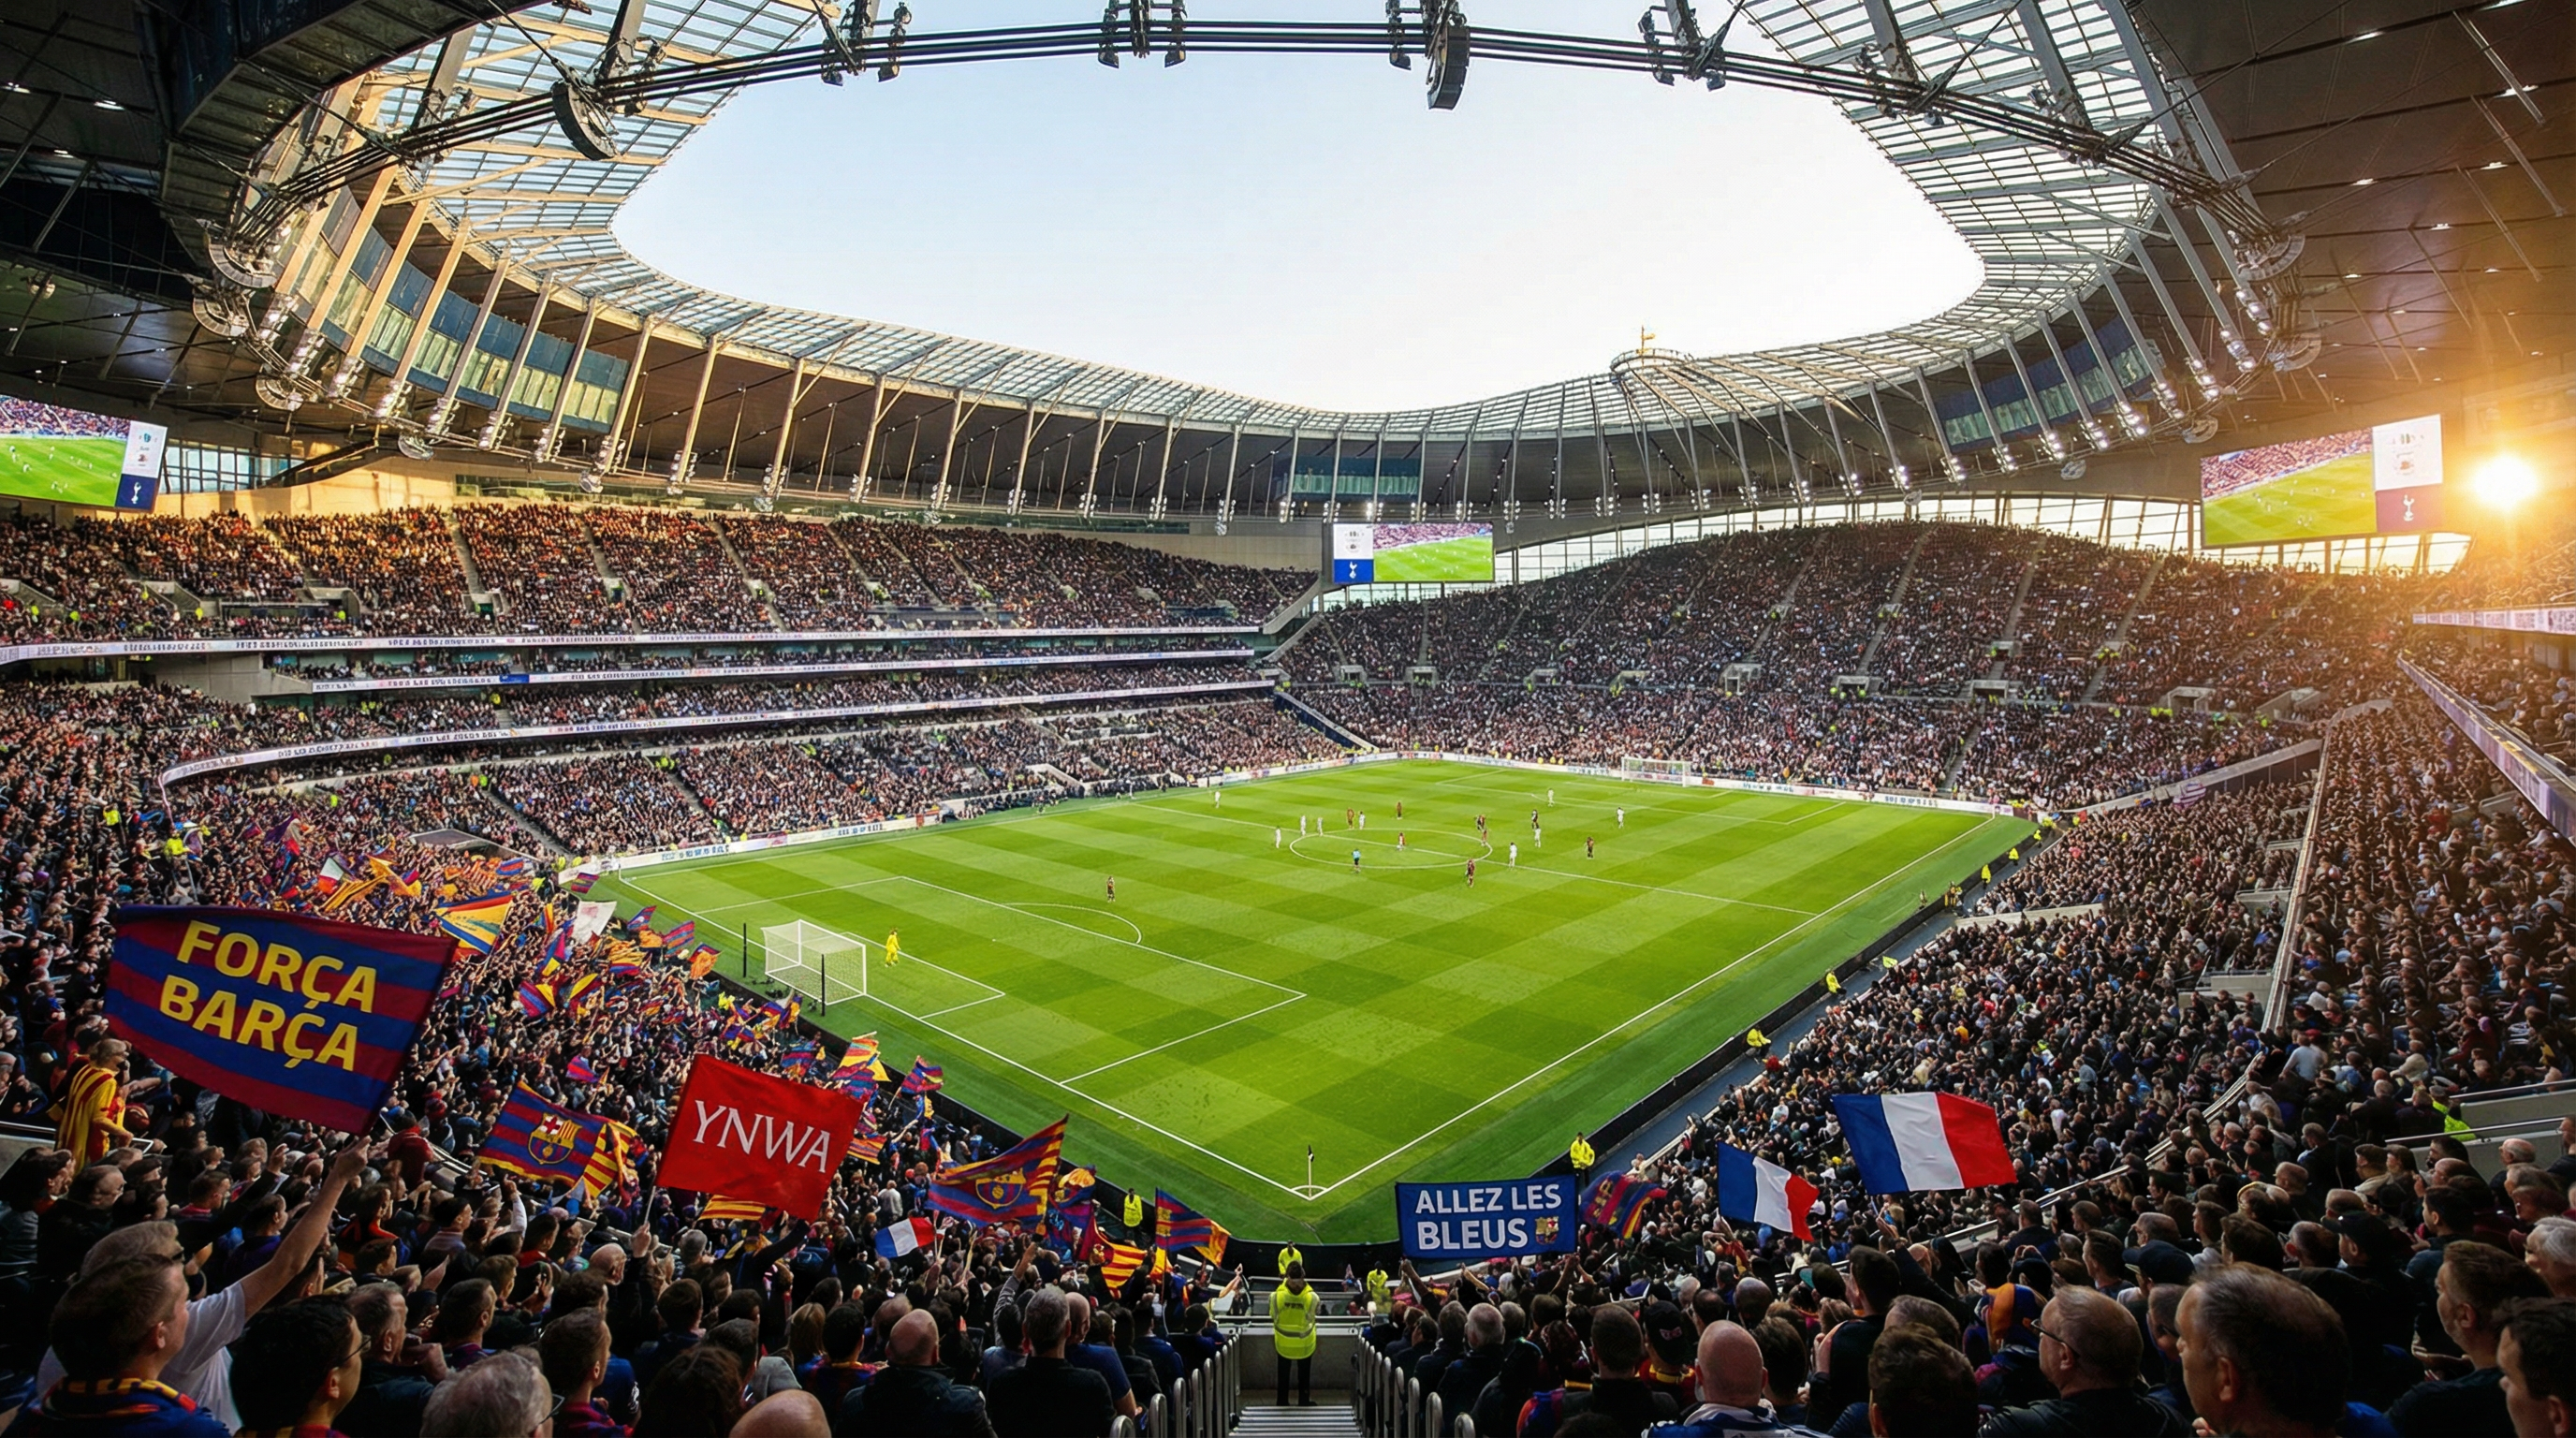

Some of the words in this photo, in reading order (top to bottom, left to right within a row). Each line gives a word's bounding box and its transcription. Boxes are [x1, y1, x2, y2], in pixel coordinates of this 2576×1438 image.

[177, 920, 376, 1013] FORÇA
[160, 975, 358, 1071] BARÇA
[693, 1100, 830, 1173] YNWA
[1415, 1187, 1503, 1214] ALLEZ
[1511, 1183, 1562, 1211] LES
[1417, 1218, 1529, 1250] BLEUS
